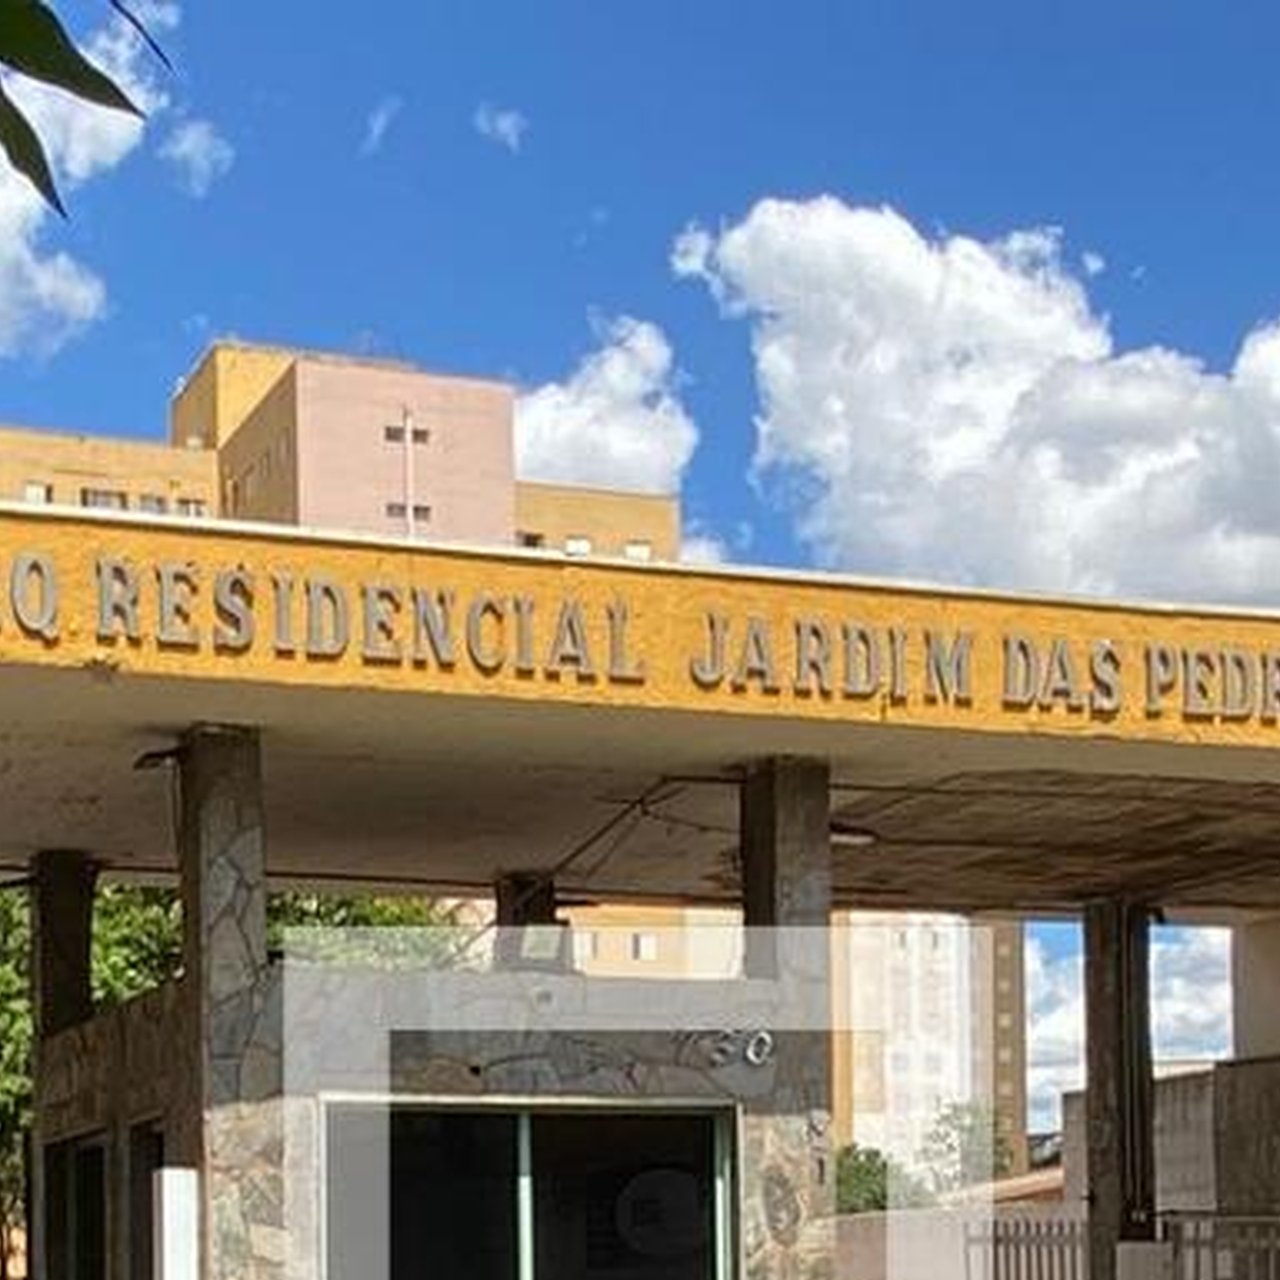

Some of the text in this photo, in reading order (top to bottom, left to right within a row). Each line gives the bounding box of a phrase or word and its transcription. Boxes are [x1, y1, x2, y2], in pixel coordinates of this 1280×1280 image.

[95, 553, 645, 685] RESIDENCIAL
[691, 611, 973, 708] JARDIM
[1002, 635, 1120, 713] DAS
